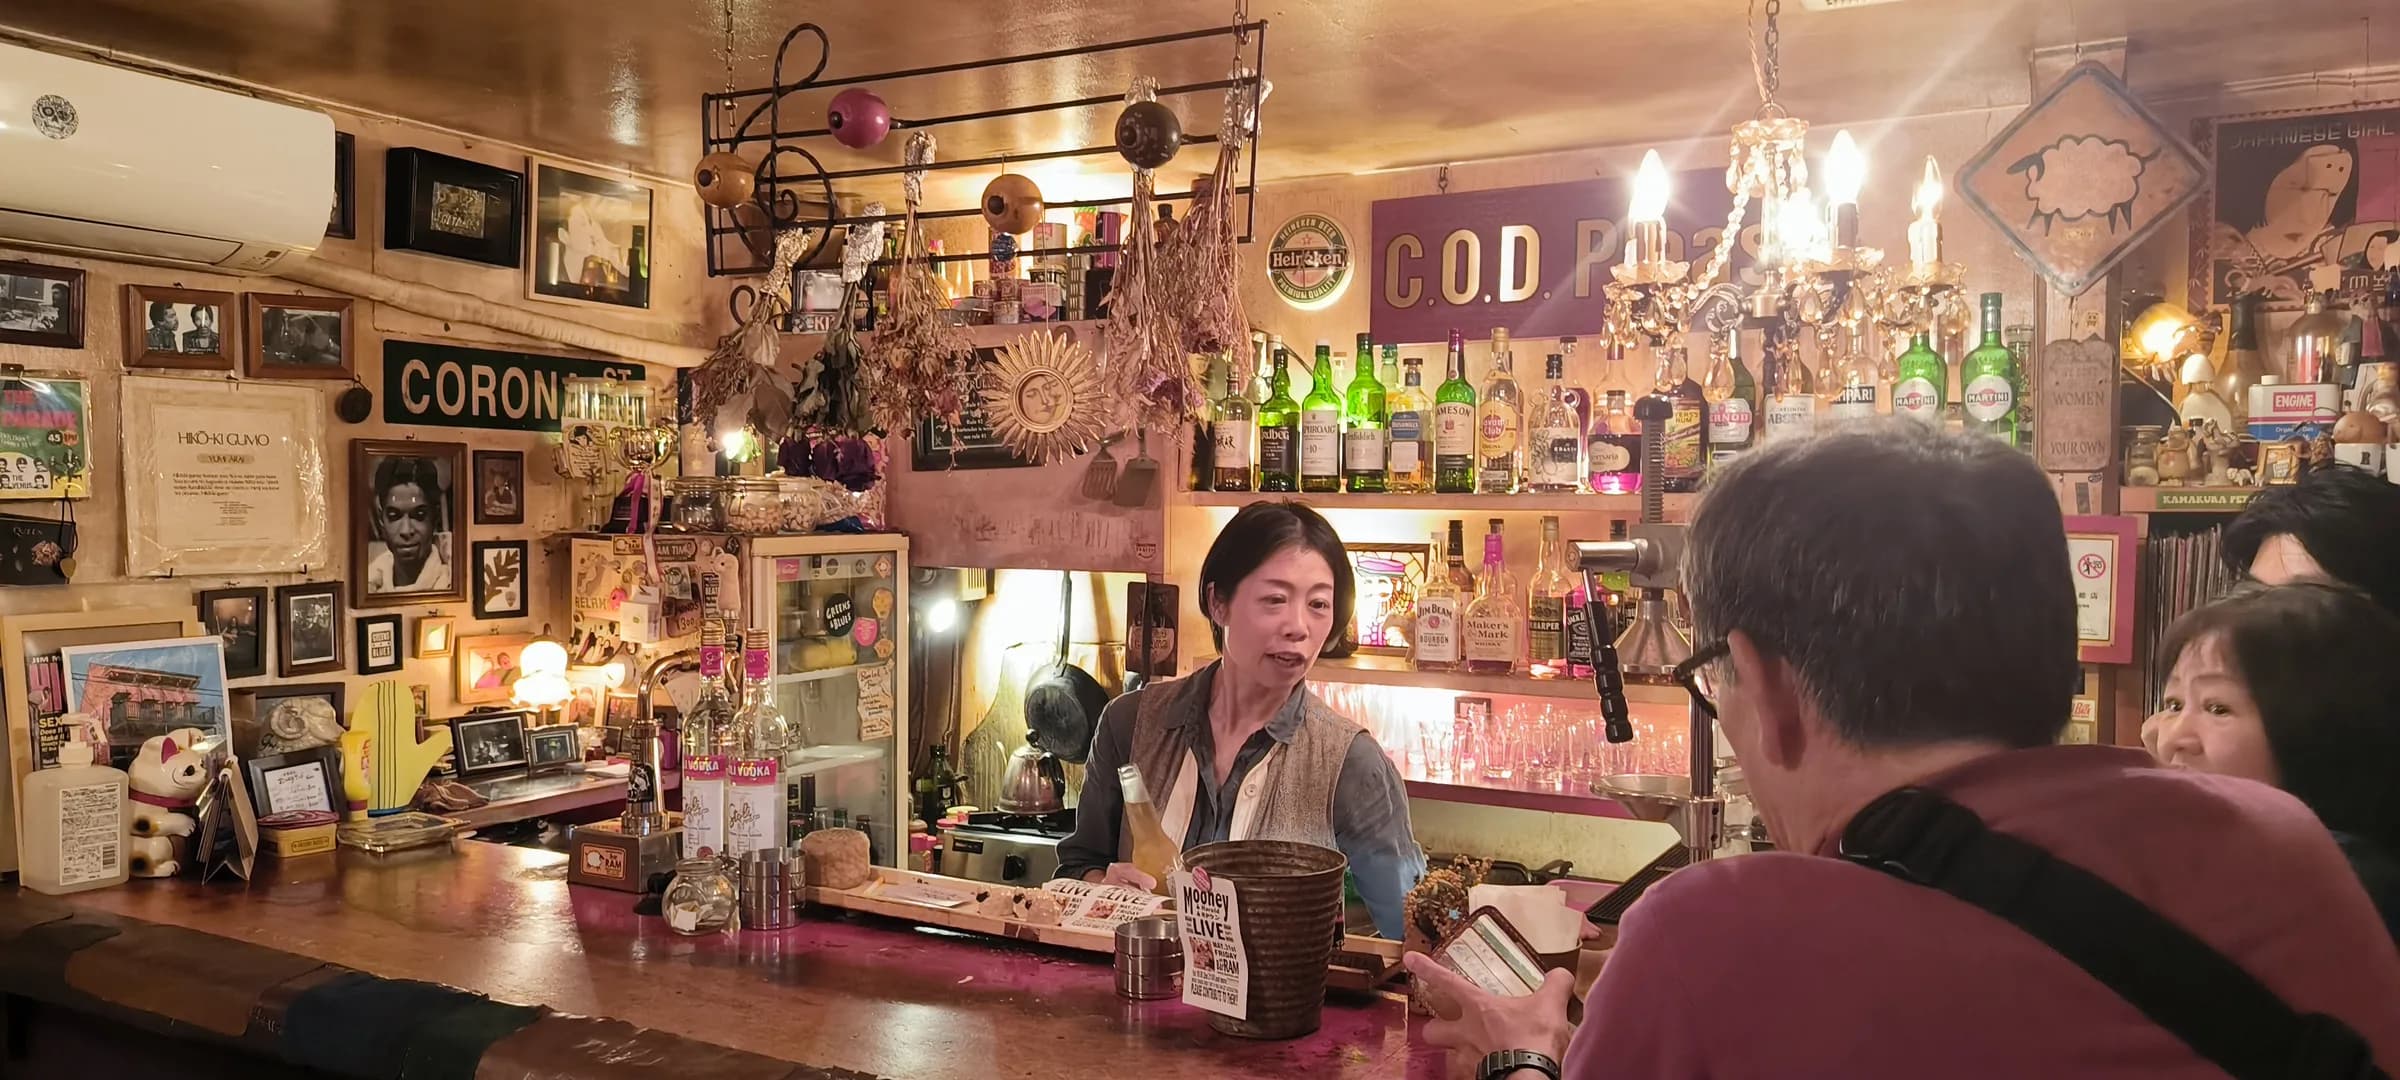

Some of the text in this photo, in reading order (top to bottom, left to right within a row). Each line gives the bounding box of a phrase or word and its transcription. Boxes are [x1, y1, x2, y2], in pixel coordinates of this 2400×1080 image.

[1273, 251, 1342, 267] Heineken
[401, 358, 576, 420] CORON
[1895, 395, 1936, 407] MARTINI
[1967, 391, 2009, 404] MARTINI
[2275, 394, 2314, 408] ENGINE
[1437, 404, 1471, 417] AMESON
[1709, 412, 1751, 424] ERNOD
[2163, 495, 2227, 504] KAMAKURA
[1417, 603, 1453, 619] JIM BEAM
[1467, 621, 1509, 631] Maker's
[1419, 634, 1449, 644] BOURBON
[1478, 630, 1509, 639] Mark
[39, 716, 62, 729] SEX
[688, 759, 720, 772] VODKA
[737, 764, 771, 778] VODKA
[1107, 892, 1141, 905] LIVE
[1183, 885, 1229, 922] Mooney
[1192, 917, 1226, 941] LIVE
